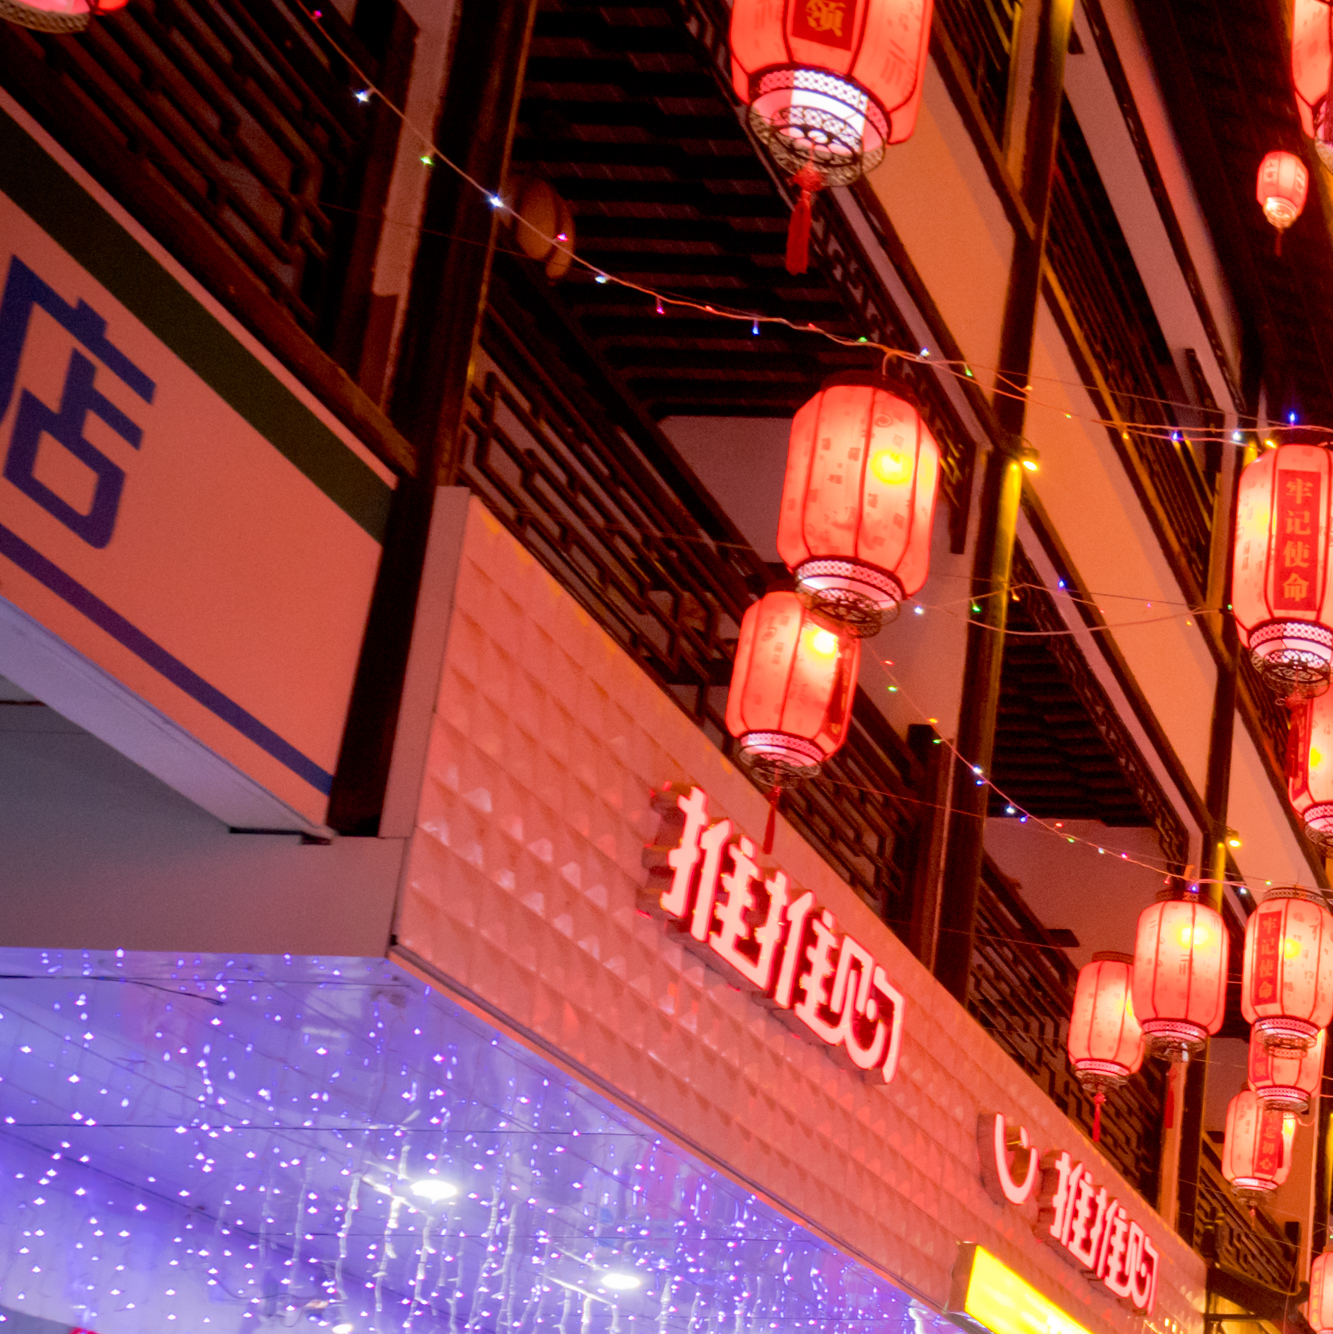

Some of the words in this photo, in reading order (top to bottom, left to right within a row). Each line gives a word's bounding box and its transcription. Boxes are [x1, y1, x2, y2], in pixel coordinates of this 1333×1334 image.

[0, 253, 157, 550] 店
[1281, 477, 1314, 603] 牢记使命
[1259, 917, 1276, 1000] 牢记使命
